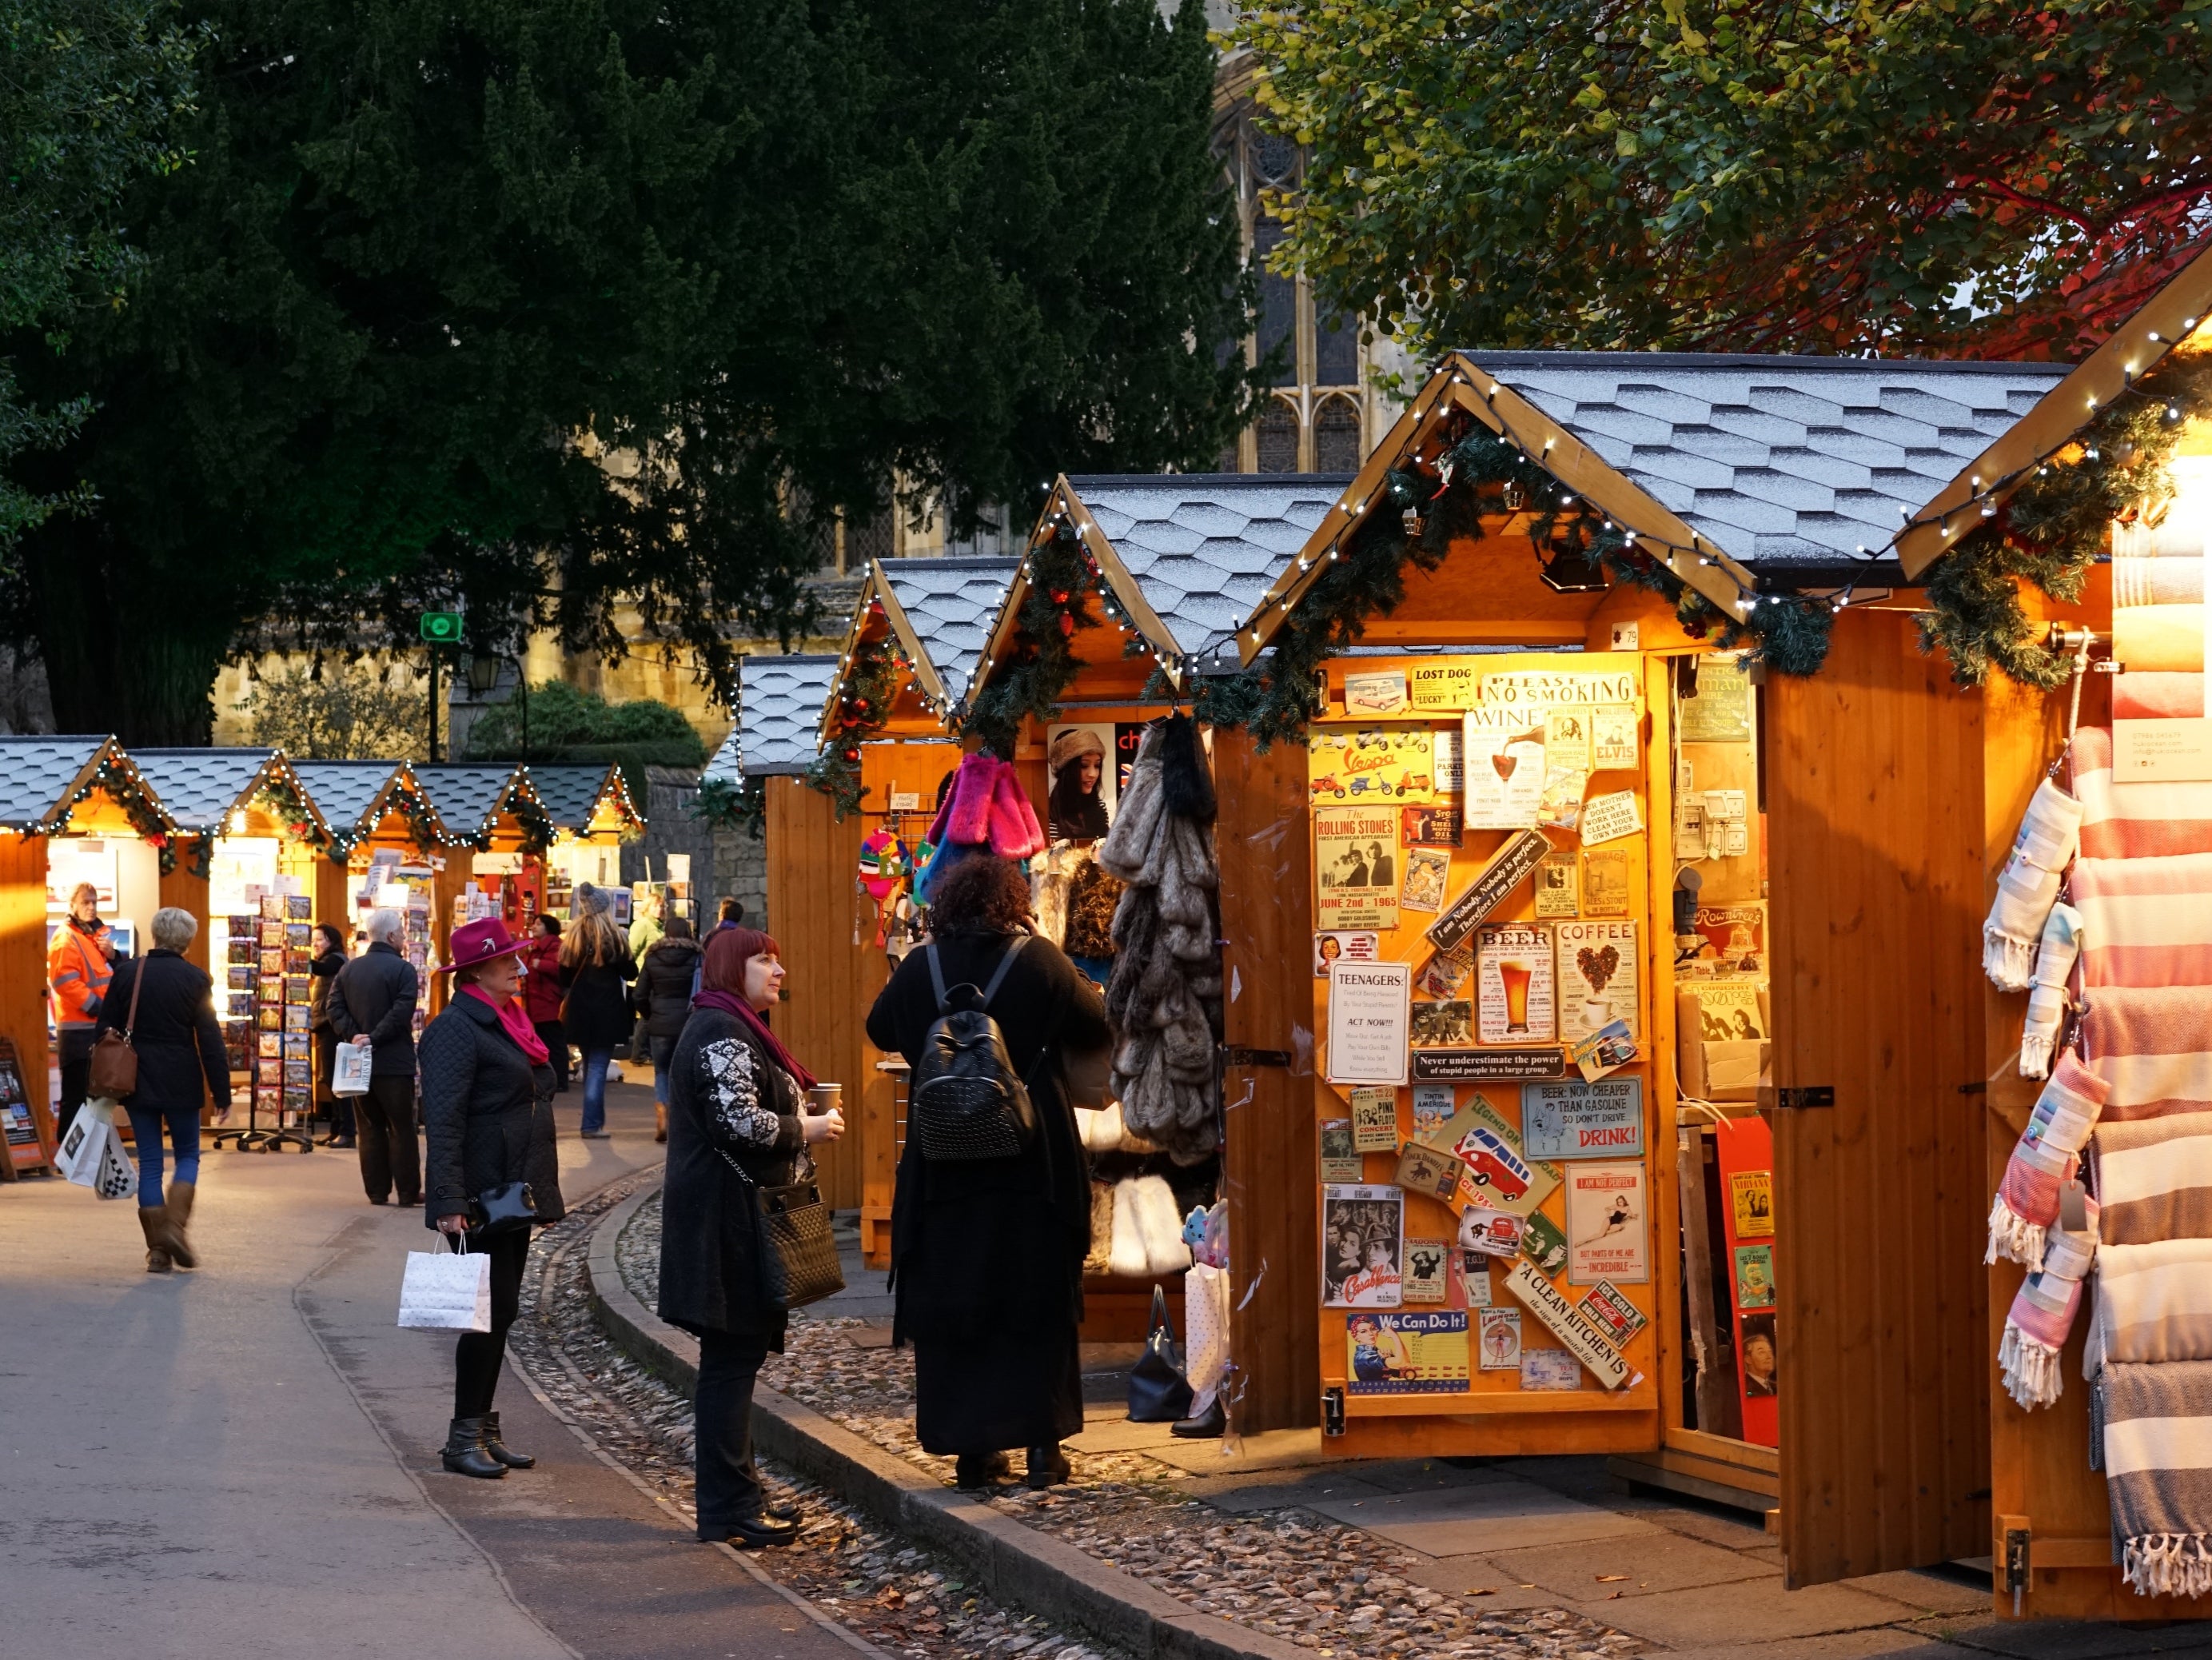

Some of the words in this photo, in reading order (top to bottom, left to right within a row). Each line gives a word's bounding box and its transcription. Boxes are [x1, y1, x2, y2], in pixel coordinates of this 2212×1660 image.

[1628, 631, 1636, 643] 79
[1416, 670, 1445, 680] LOST
[1448, 668, 1472, 678] DOG
[1487, 686, 1517, 702] NO
[1526, 676, 1629, 702] SMOKING
[1492, 677, 1580, 687] PLEASE
[1700, 678, 1744, 691] man
[1473, 709, 1539, 726] WINE
[1596, 746, 1635, 759] ELVIS
[1343, 748, 1398, 776] Vespa
[1581, 801, 1597, 812] OUR
[1600, 792, 1632, 808] MOTHER
[1346, 808, 1365, 820] The
[1584, 816, 1608, 826] WORK
[1610, 808, 1632, 819] HERE
[1590, 803, 1622, 817] DOESN'T
[1317, 821, 1356, 836] ROLLING
[1358, 820, 1393, 835] STONES
[1586, 821, 1612, 834] CLEAN
[1614, 815, 1635, 827] YOUR
[1592, 831, 1611, 840] OWN
[1612, 824, 1632, 835] MESS
[1587, 852, 1625, 863] OURAGE
[1437, 929, 1444, 939] I
[1443, 922, 1454, 934] am
[1479, 868, 1506, 896] Nobody
[1504, 862, 1513, 871] is
[1512, 838, 1537, 866] perfect.
[1320, 898, 1343, 908] JUNE
[1346, 898, 1363, 908] 2nd
[1373, 897, 1397, 907] 1965
[1458, 899, 1492, 933] Therefore
[1490, 892, 1497, 901] I
[1496, 884, 1508, 896] am
[1506, 860, 1532, 888] perfect.
[1695, 908, 1761, 927] Rowntree's
[1481, 932, 1548, 945] BEER
[1560, 924, 1632, 940] COFFEE
[1695, 966, 1711, 975] Table
[1338, 974, 1404, 987] TEENAGERS:
[1420, 1056, 1447, 1065] Never
[1449, 1055, 1513, 1065] underestimate
[1531, 1056, 1559, 1065] power
[1385, 1087, 1393, 1098] 23
[1541, 1087, 1567, 1099] BEER:
[1569, 1085, 1590, 1099] NOW
[1592, 1084, 1631, 1096] CHEAPER
[1377, 1101, 1394, 1114] PINK
[1557, 1100, 1583, 1112] THAN
[1584, 1099, 1627, 1111] GASOLINE
[1378, 1114, 1395, 1125] FLOYD
[1471, 1099, 1506, 1131] LEGEND
[1506, 1127, 1522, 1145] ON
[1562, 1115, 1573, 1124] SO
[1576, 1114, 1599, 1123] DON'T
[1579, 1126, 1636, 1147] DRINK!
[1609, 1178, 1632, 1187] PERFECT
[1734, 1178, 1769, 1190] NIRVANA
[1624, 1248, 1635, 1257] ARE
[1588, 1262, 1629, 1273] INCREDIBLE
[1344, 1265, 1401, 1303] Casablanca
[1599, 1283, 1612, 1299] ICE
[1612, 1295, 1634, 1318] COLD
[1379, 1315, 1399, 1329] We
[1401, 1315, 1426, 1328] Can
[1429, 1314, 1449, 1328] Do
[1450, 1314, 1465, 1327] It!
[1482, 1313, 1520, 1327] LAUNDRY
[1520, 1267, 1533, 1281] A
[1531, 1276, 1568, 1316] CLEAN
[1564, 1310, 1616, 1363] KITCHEN
[1609, 1356, 1626, 1375] IS
[1581, 1303, 1599, 1322] SOLD
[1596, 1318, 1614, 1335] HERE
[1529, 1299, 1540, 1311] the
[1540, 1310, 1552, 1323] sign
[1551, 1321, 1560, 1331] of
[1563, 1333, 1584, 1356] wasted
[1582, 1352, 1594, 1365] life
